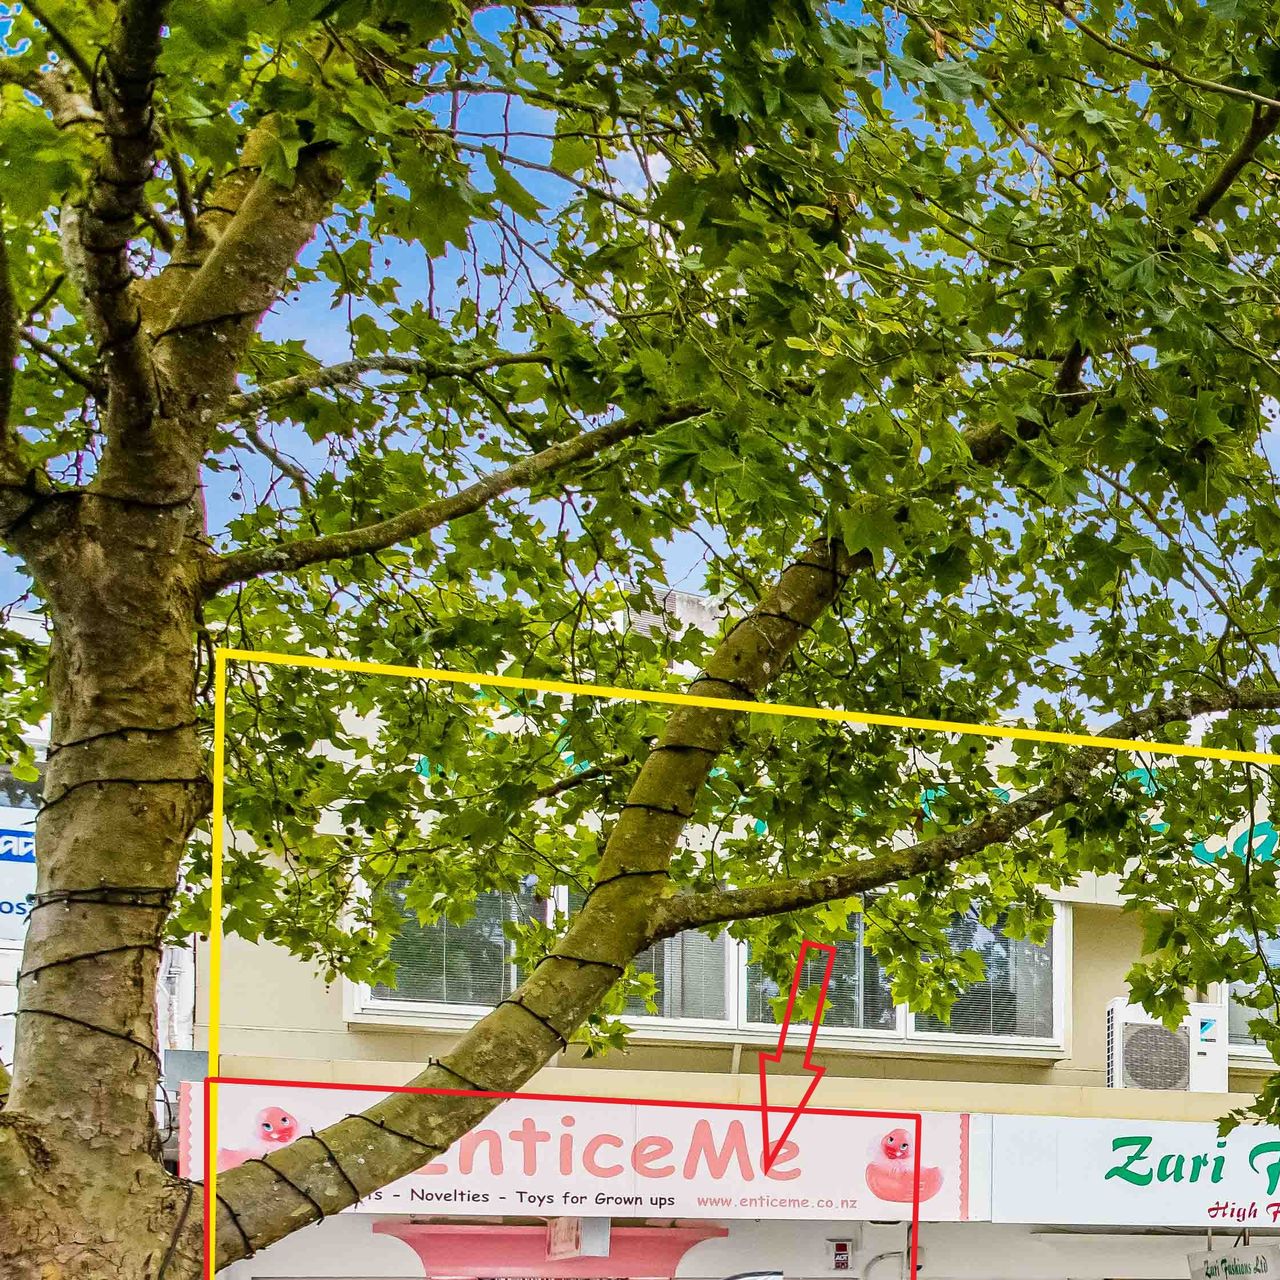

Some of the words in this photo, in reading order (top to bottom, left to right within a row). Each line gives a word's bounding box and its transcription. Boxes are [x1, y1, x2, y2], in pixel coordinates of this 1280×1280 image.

[412, 1115, 801, 1181] nticeMe
[1104, 1135, 1228, 1187] Zari
[410, 1188, 490, 1203] Novelties
[516, 1191, 555, 1204] Toys
[562, 1192, 588, 1205] for
[595, 1192, 643, 1205] Grown
[650, 1195, 675, 1209] ups
[696, 1194, 858, 1209] www.enticeme.co.nz
[1207, 1200, 1259, 1221] High
[1204, 1259, 1220, 1278] Zari
[1220, 1256, 1252, 1280] Fashions
